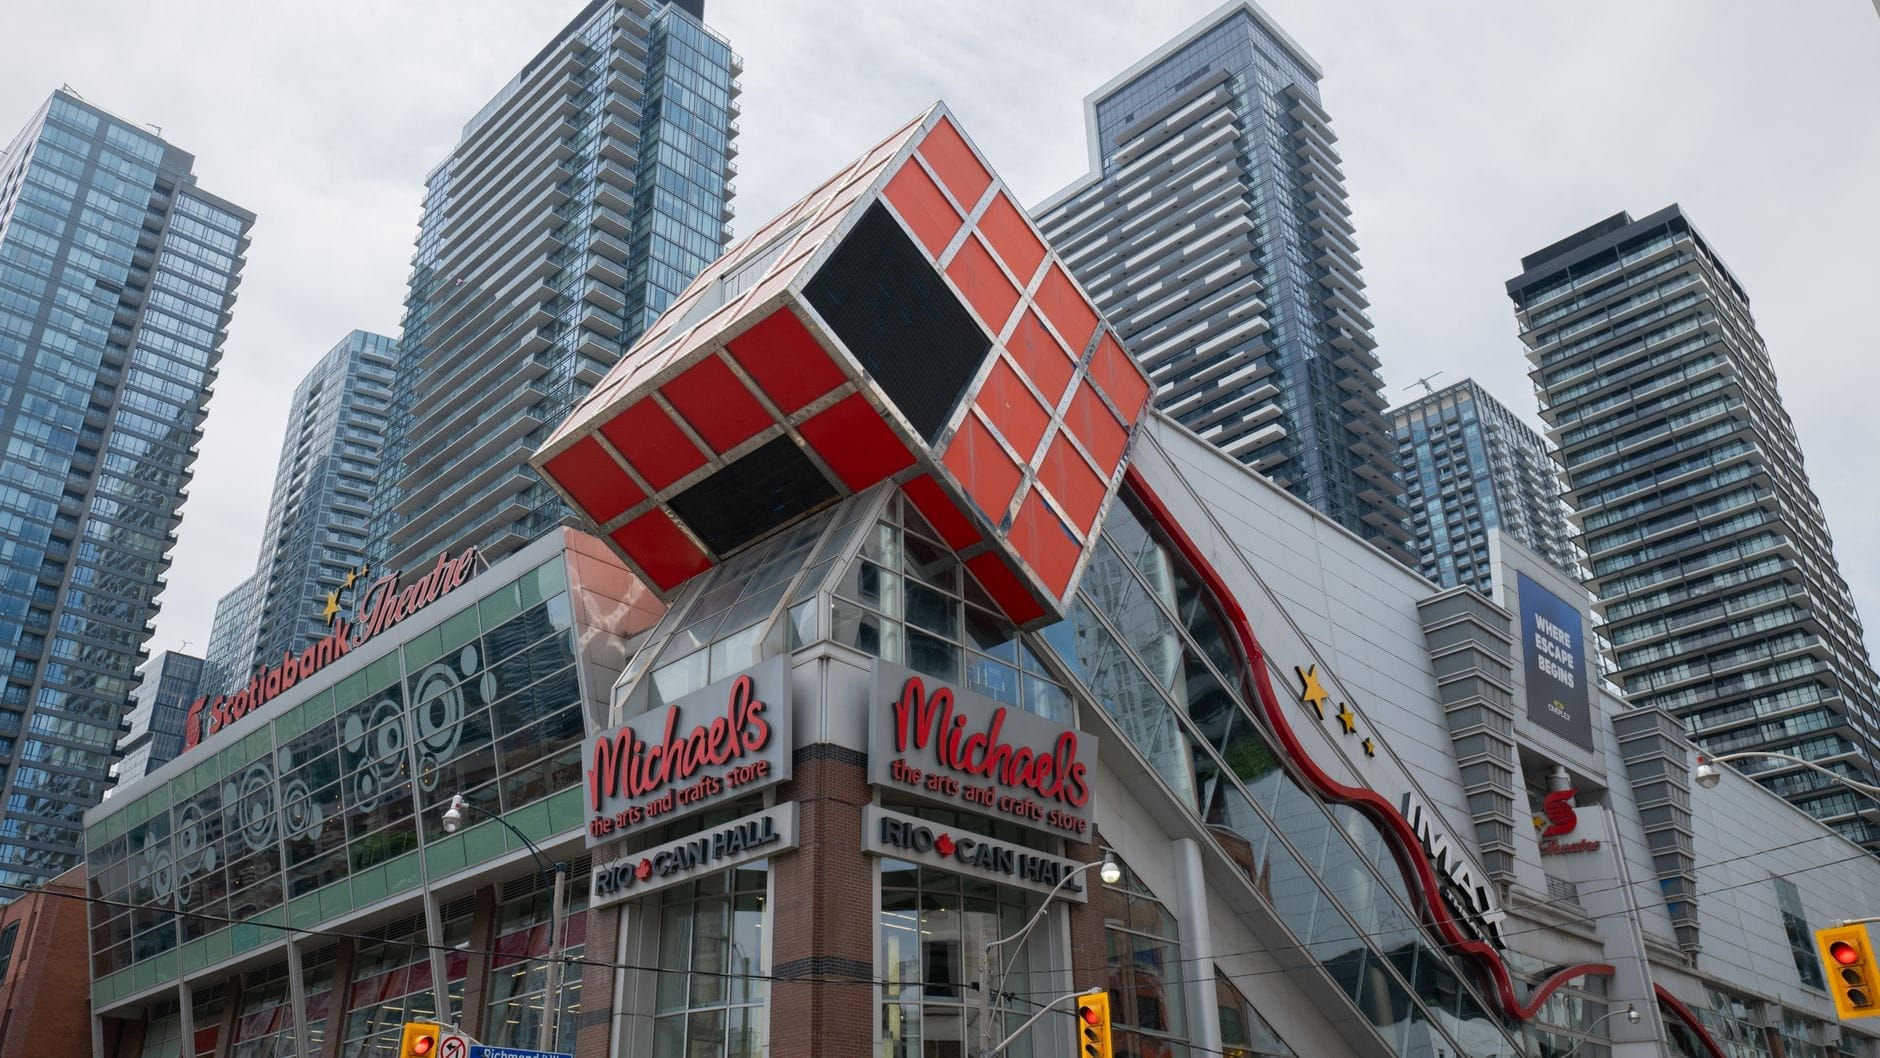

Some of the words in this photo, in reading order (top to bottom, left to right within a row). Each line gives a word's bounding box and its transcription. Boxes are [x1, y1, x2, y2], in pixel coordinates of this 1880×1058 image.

[209, 617, 352, 735] Scotiabank
[353, 547, 476, 647] Theatre
[1535, 612, 1572, 649] WHERE
[1535, 632, 1575, 670] ESCAPE
[1538, 653, 1575, 689] BEGINS
[588, 674, 771, 811] Michaels
[892, 676, 1089, 808] Michaels
[589, 814, 614, 838] the
[615, 805, 642, 829] arts
[645, 789, 675, 817] and
[677, 775, 722, 806] crafts
[726, 759, 770, 789] store
[891, 759, 923, 785] the
[926, 772, 960, 797] arts
[964, 783, 996, 808] and
[999, 795, 1045, 821] crafts
[1048, 809, 1087, 834] store
[594, 861, 636, 897] RIO
[652, 838, 709, 877] CAN
[712, 816, 780, 860] HALL
[881, 816, 935, 853] RIO
[955, 837, 1015, 875] CAN
[1020, 852, 1083, 893] HALL
[1401, 791, 1508, 949] IMAX
